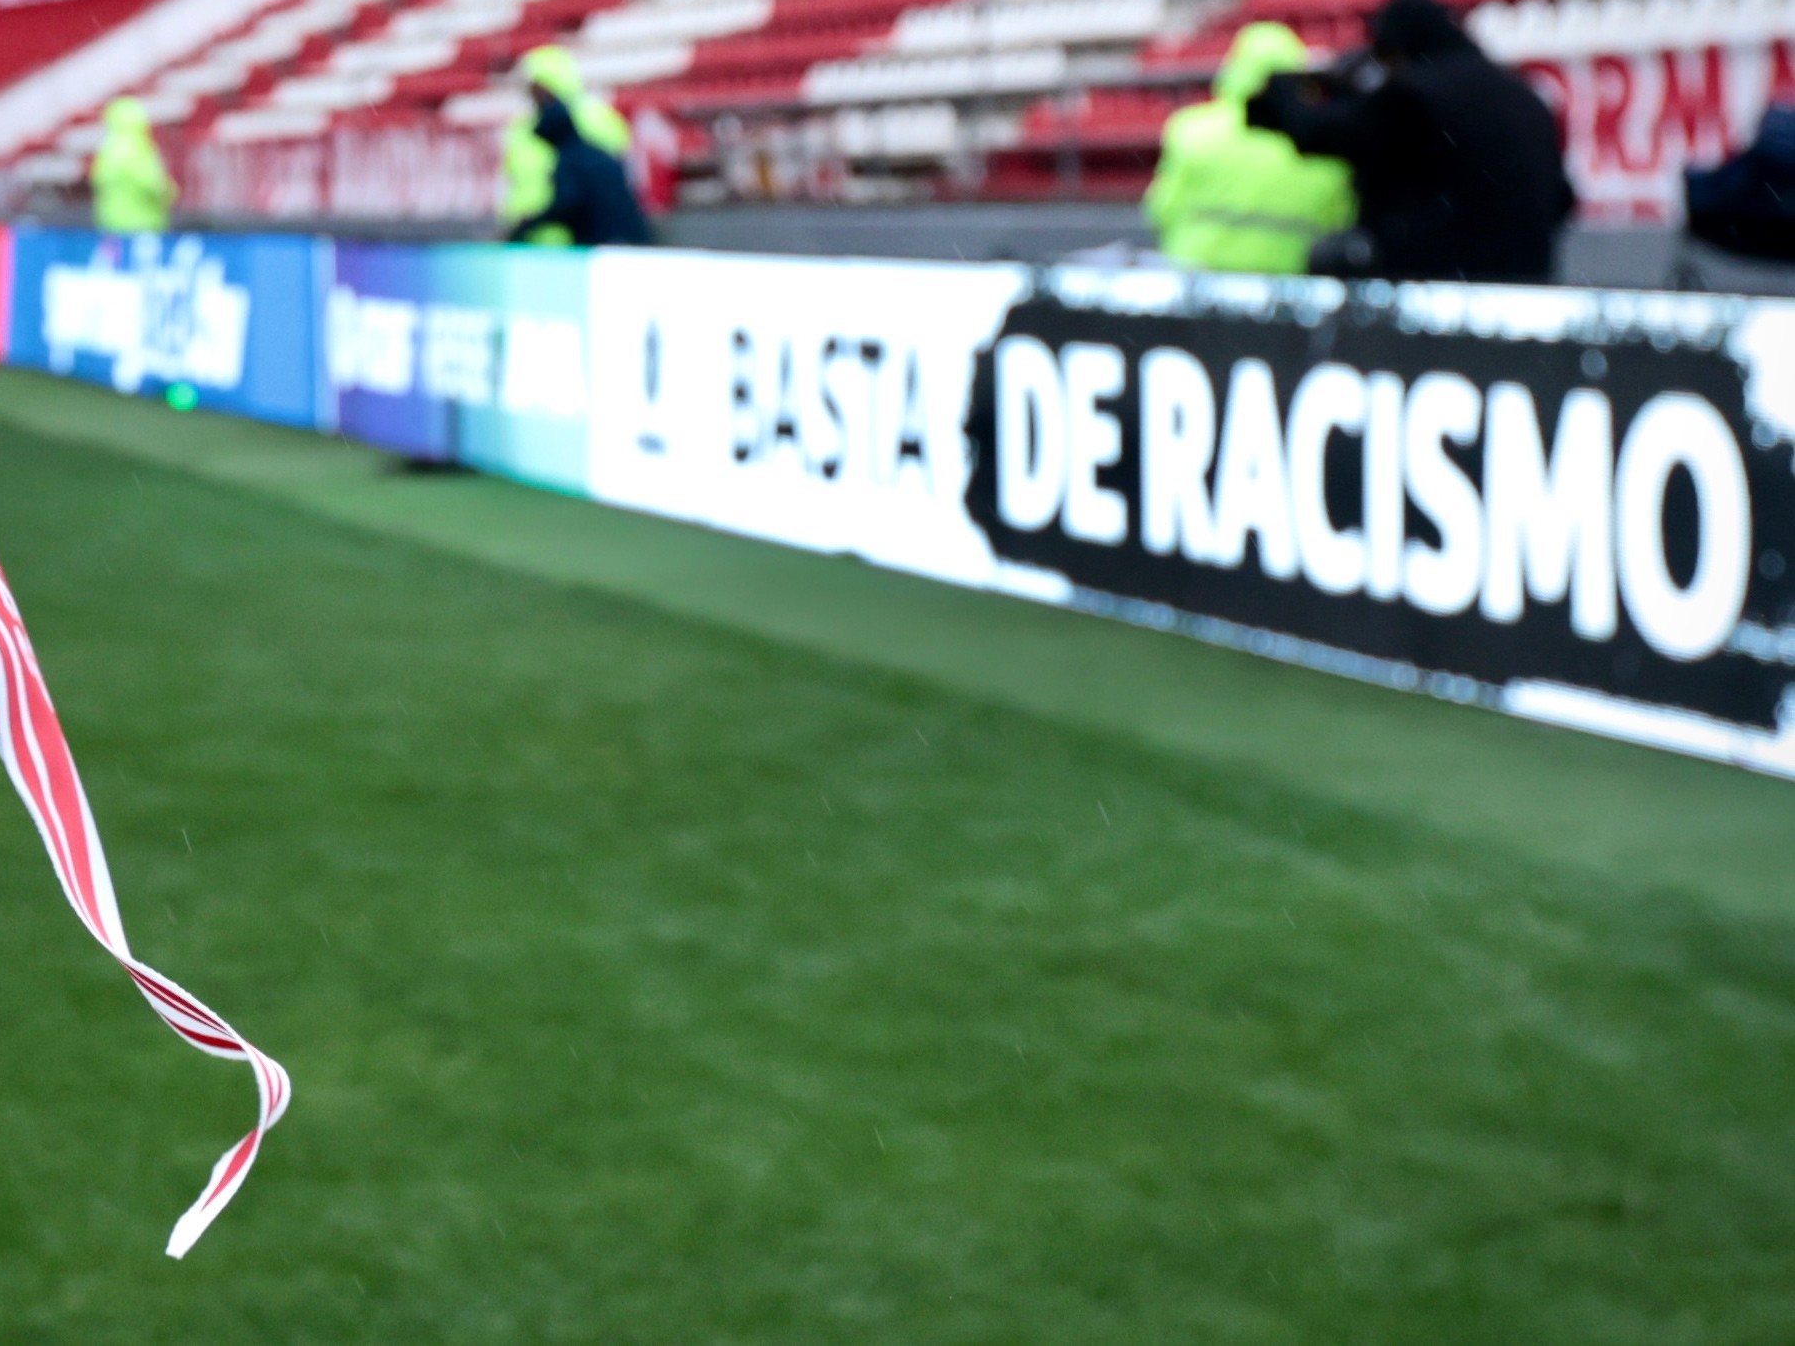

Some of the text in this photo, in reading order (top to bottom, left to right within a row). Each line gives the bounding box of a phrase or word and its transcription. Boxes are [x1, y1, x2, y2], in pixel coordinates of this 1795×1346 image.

[730, 326, 937, 496] BASTA
[994, 334, 1131, 546] DE
[1139, 344, 1753, 660] RACISMO
